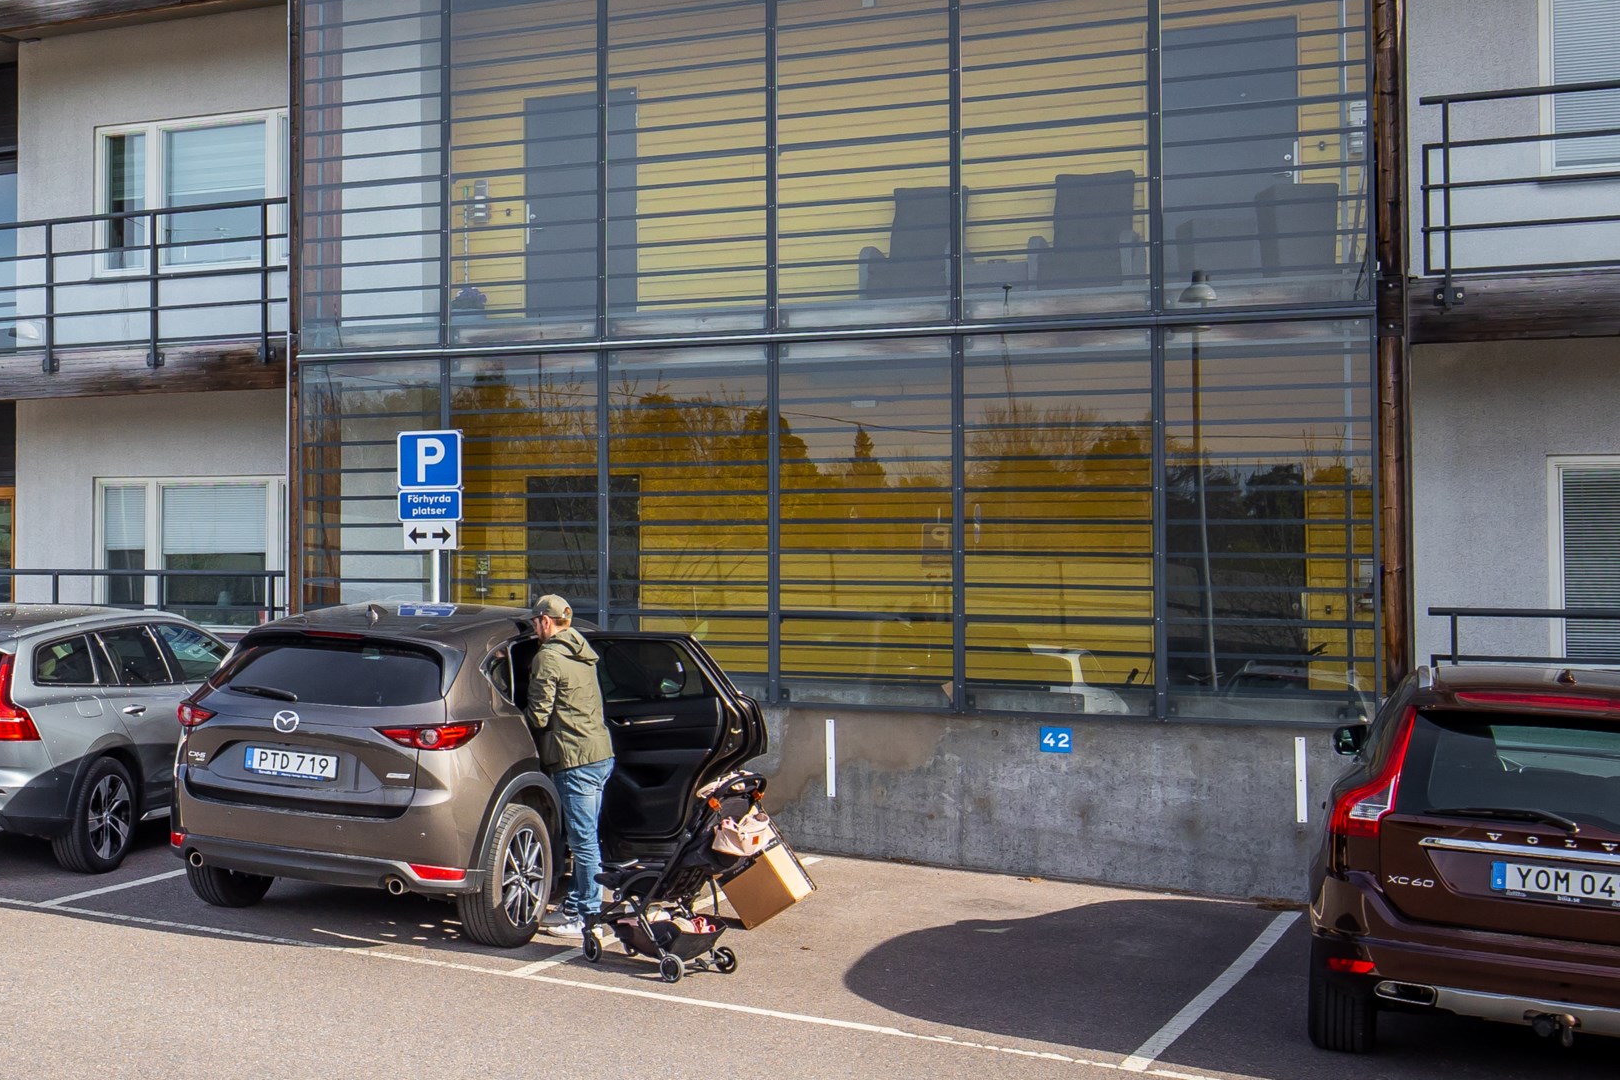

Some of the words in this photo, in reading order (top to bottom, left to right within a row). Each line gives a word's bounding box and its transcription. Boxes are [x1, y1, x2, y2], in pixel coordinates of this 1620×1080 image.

[416, 438, 446, 483] P
[407, 494, 452, 506] Förhyrda
[412, 506, 447, 516] platser
[1042, 732, 1070, 748] 42
[258, 750, 290, 770] PTD
[296, 755, 329, 774] 719
[1516, 866, 1570, 893] YOM
[1580, 874, 1620, 898] 04
